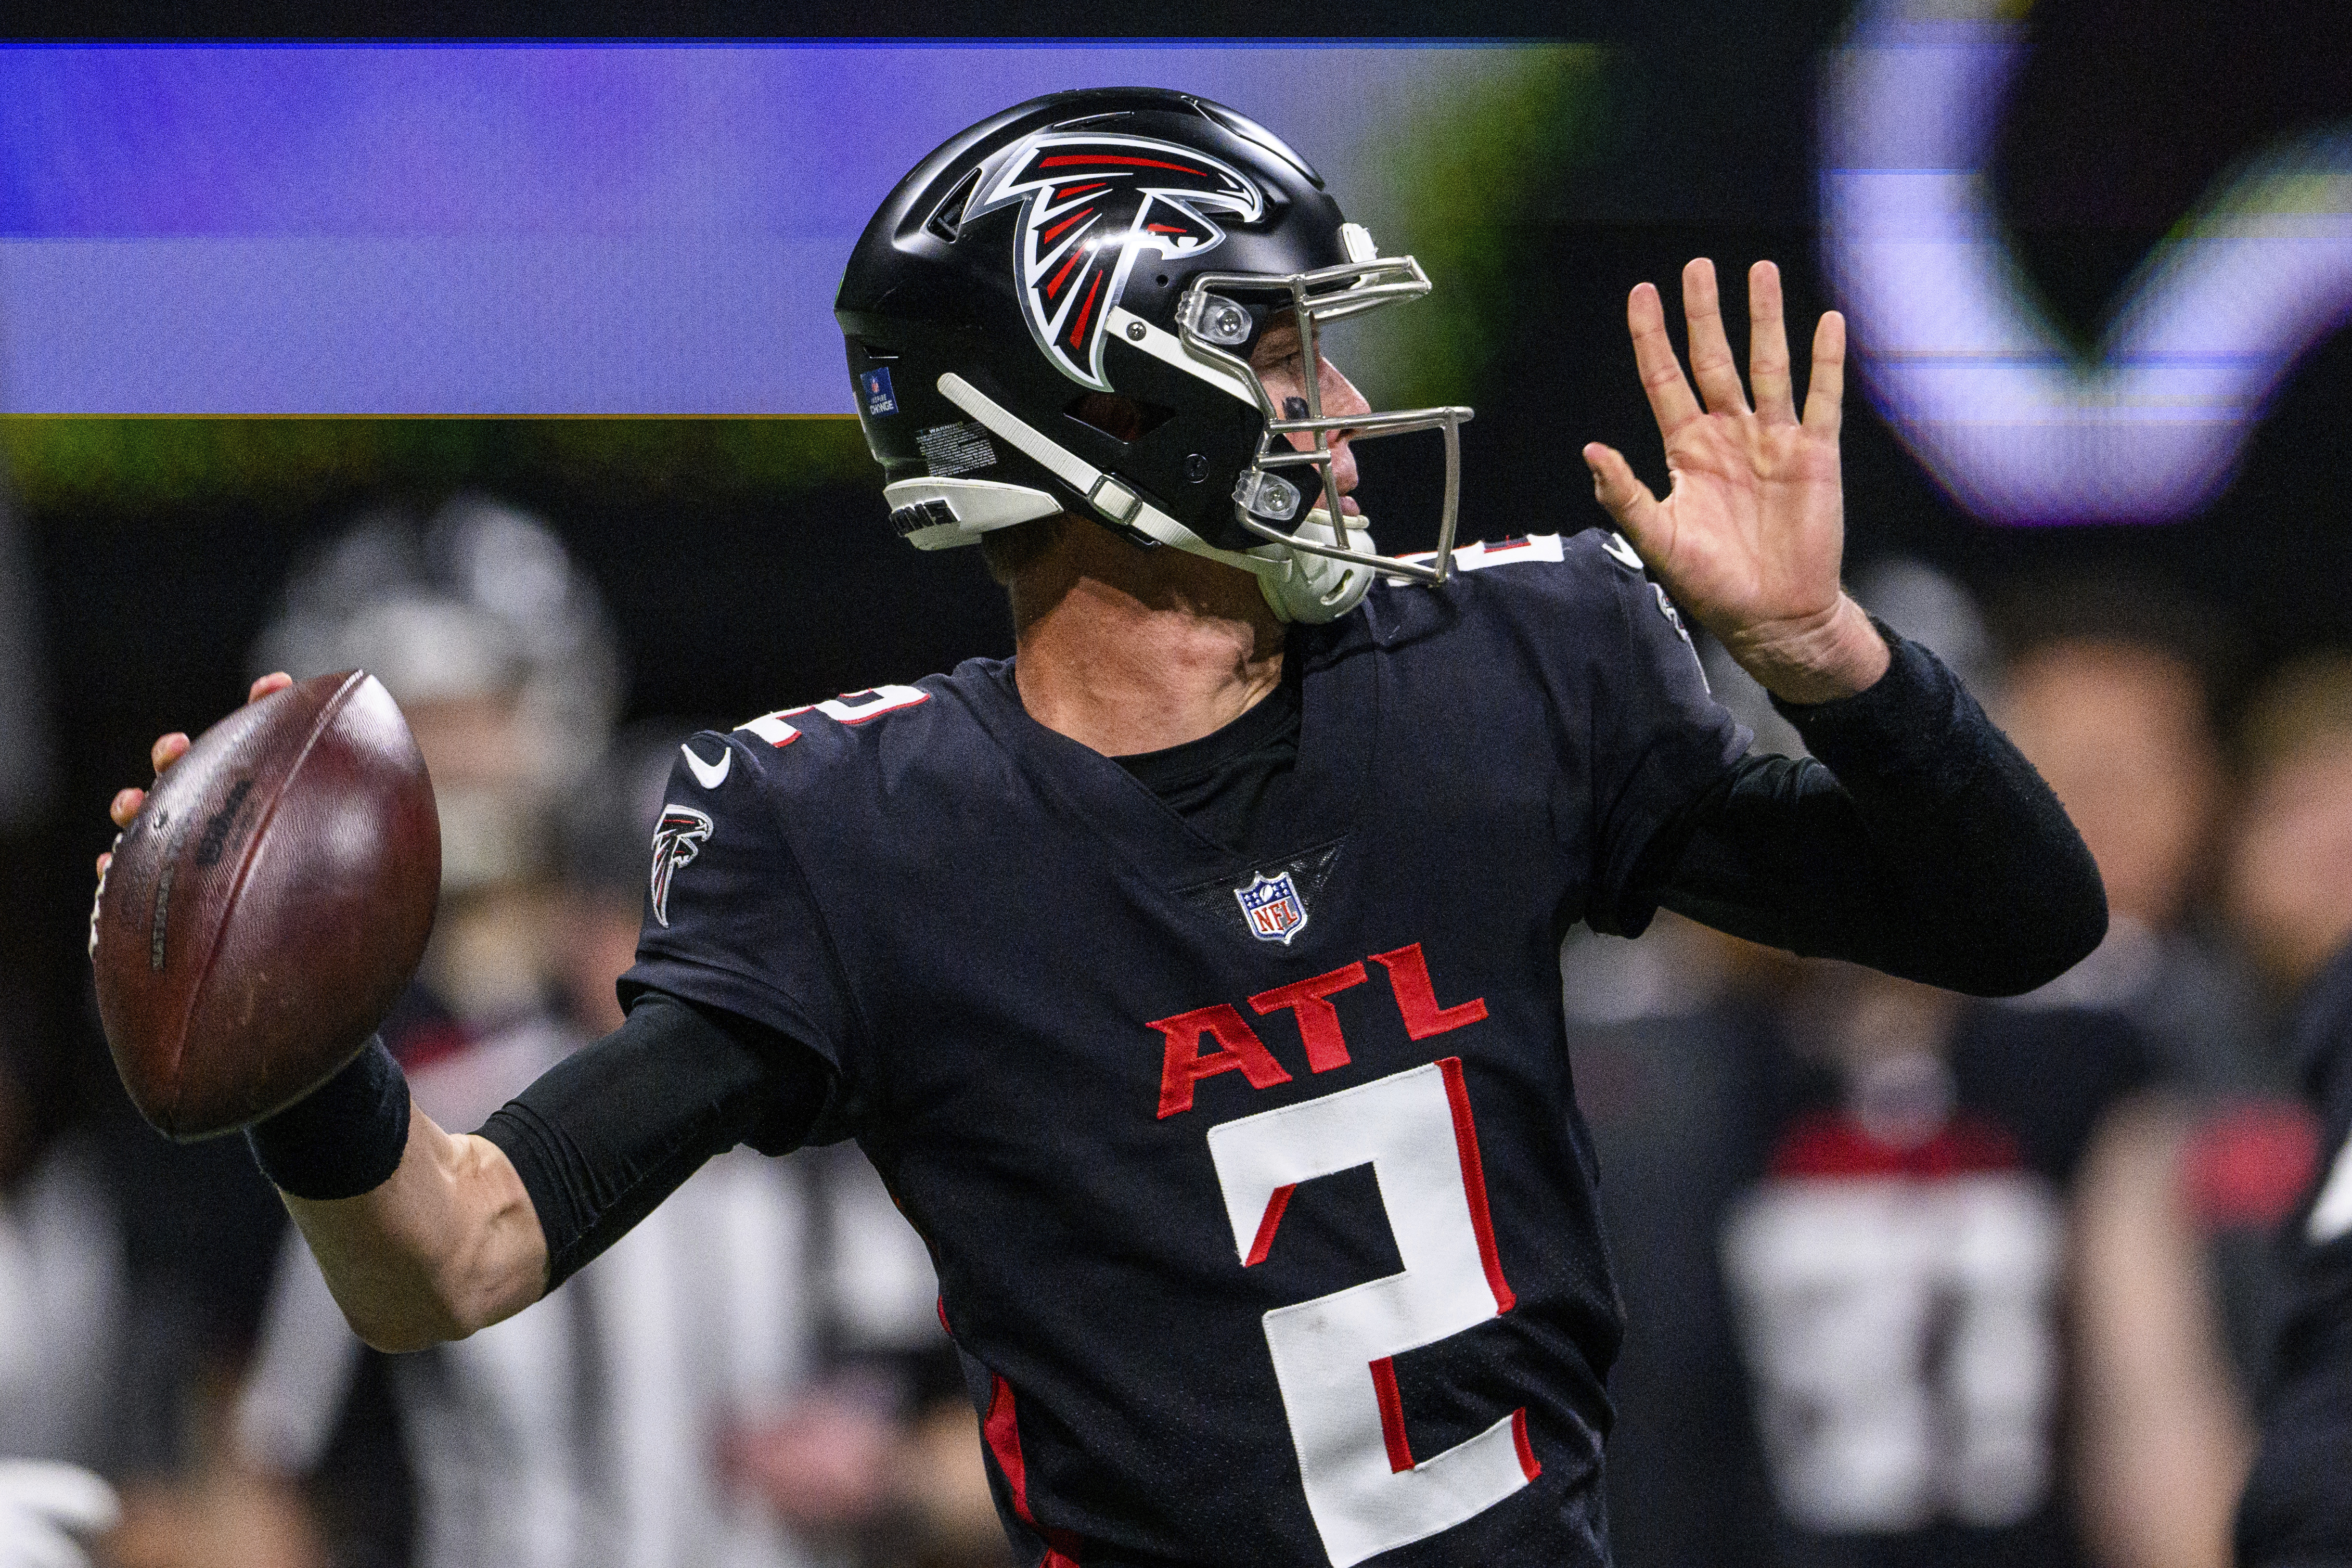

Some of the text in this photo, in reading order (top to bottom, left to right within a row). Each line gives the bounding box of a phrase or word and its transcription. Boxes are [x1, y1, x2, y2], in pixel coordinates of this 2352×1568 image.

[870, 400, 894, 415] CHANGE
[929, 421, 963, 434] WARNING
[1254, 901, 1298, 931] NFL
[1146, 942, 1489, 1119] ATL
[1207, 1057, 1541, 1568] 2
